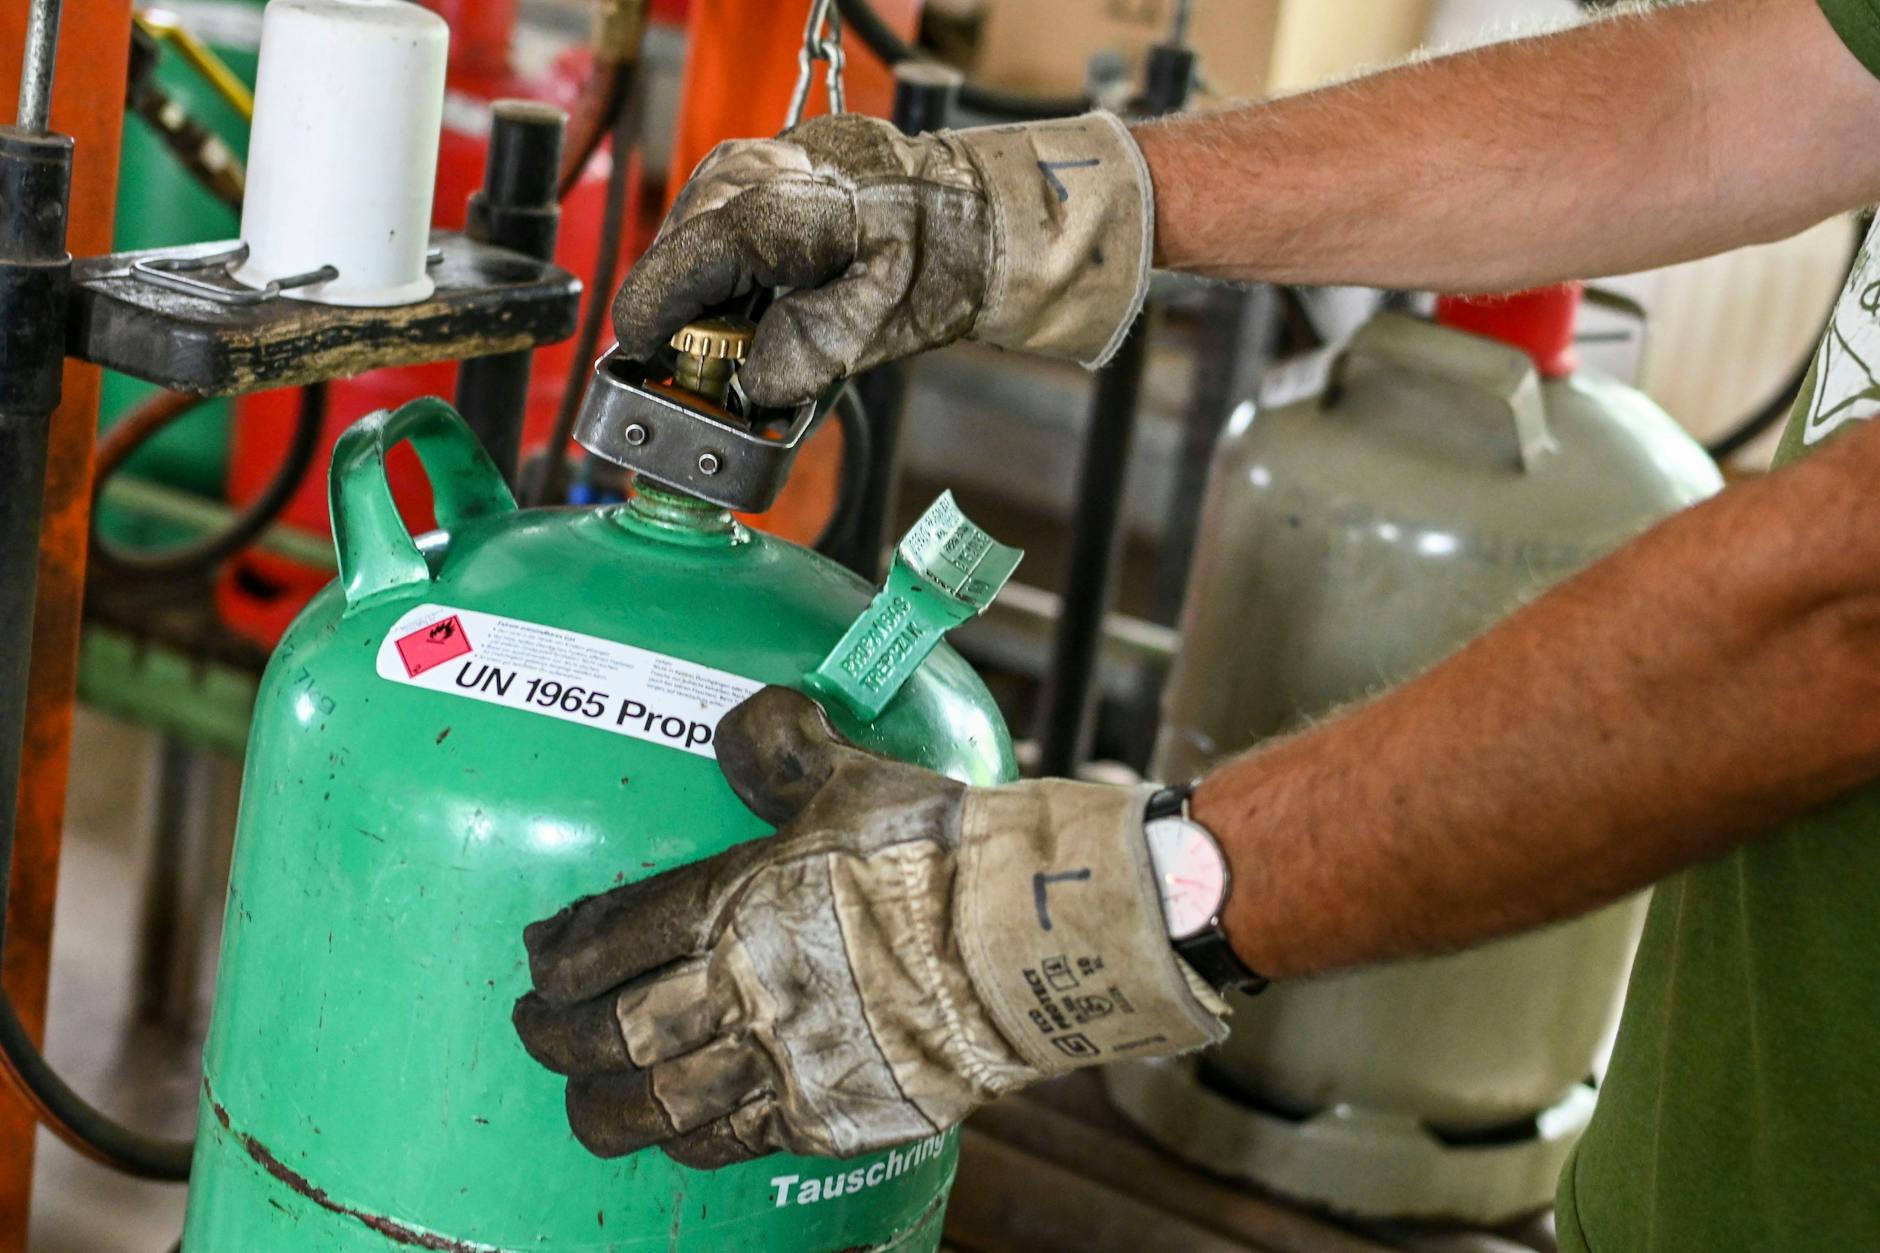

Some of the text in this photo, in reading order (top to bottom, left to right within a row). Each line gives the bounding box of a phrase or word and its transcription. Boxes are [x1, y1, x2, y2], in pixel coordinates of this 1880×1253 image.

[455, 661, 517, 696] UN
[524, 678, 610, 718] 1965
[616, 699, 715, 748] Prop
[1022, 967, 1073, 1030] PROTECT
[770, 1131, 947, 1208] Tauschring
